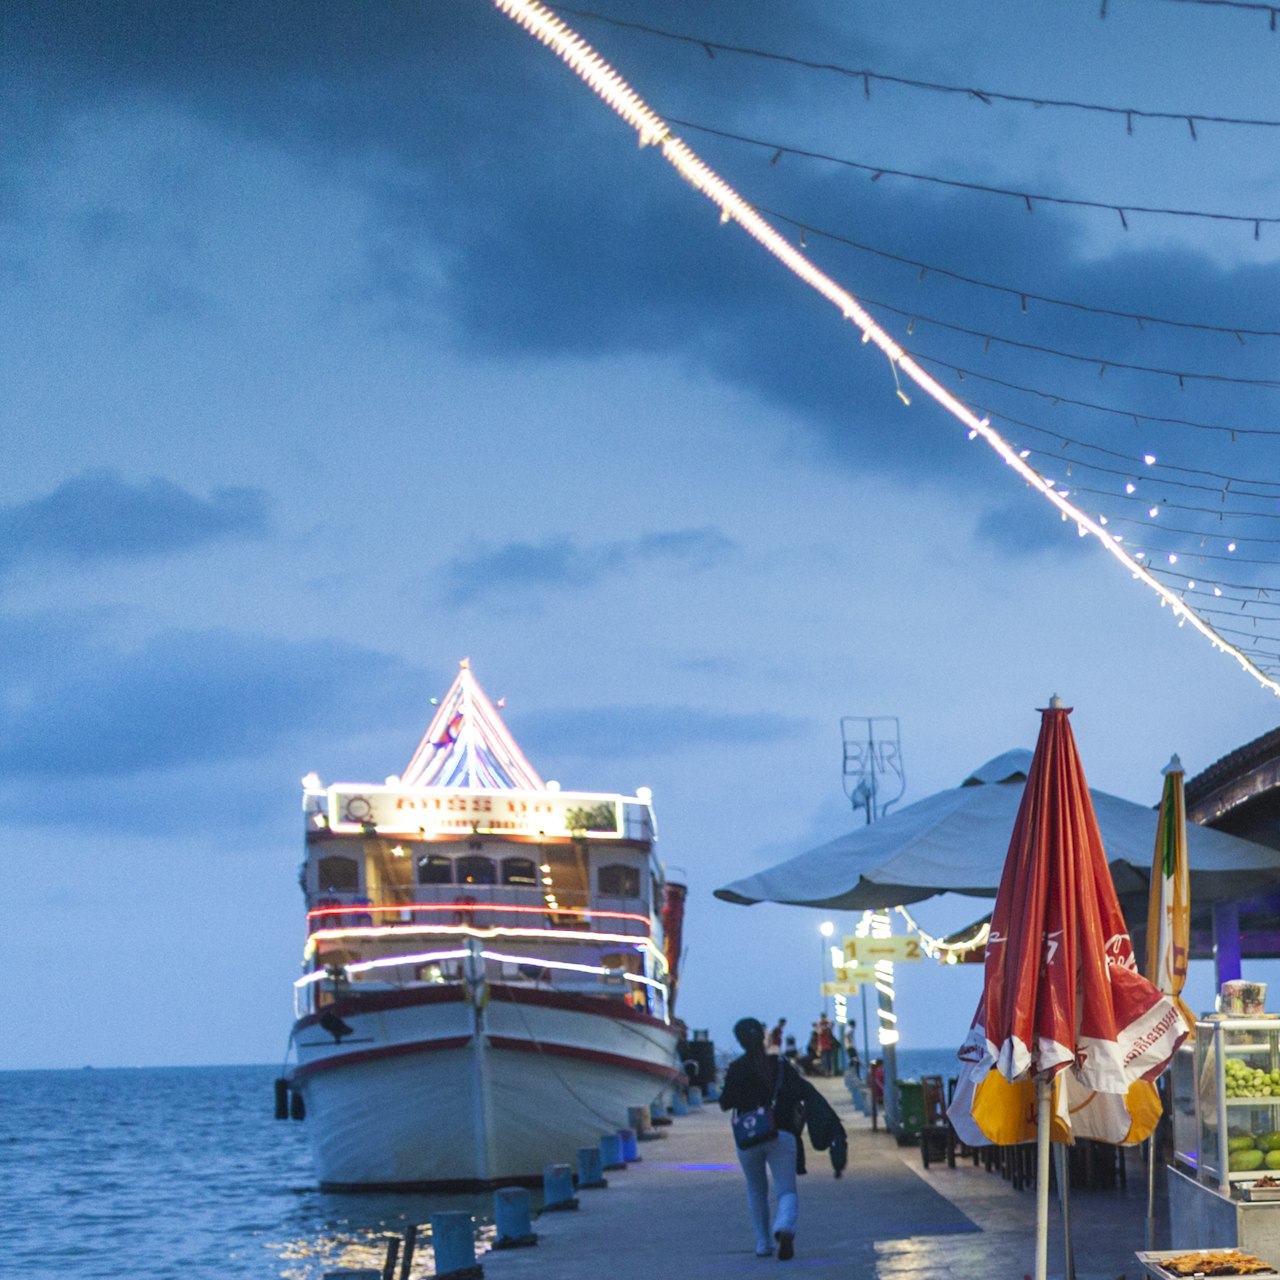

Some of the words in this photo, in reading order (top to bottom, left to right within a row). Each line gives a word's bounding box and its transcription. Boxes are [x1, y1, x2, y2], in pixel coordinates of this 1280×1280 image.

[843, 740, 901, 776] BAR
[844, 941, 857, 959] 1
[904, 940, 921, 958] 2
